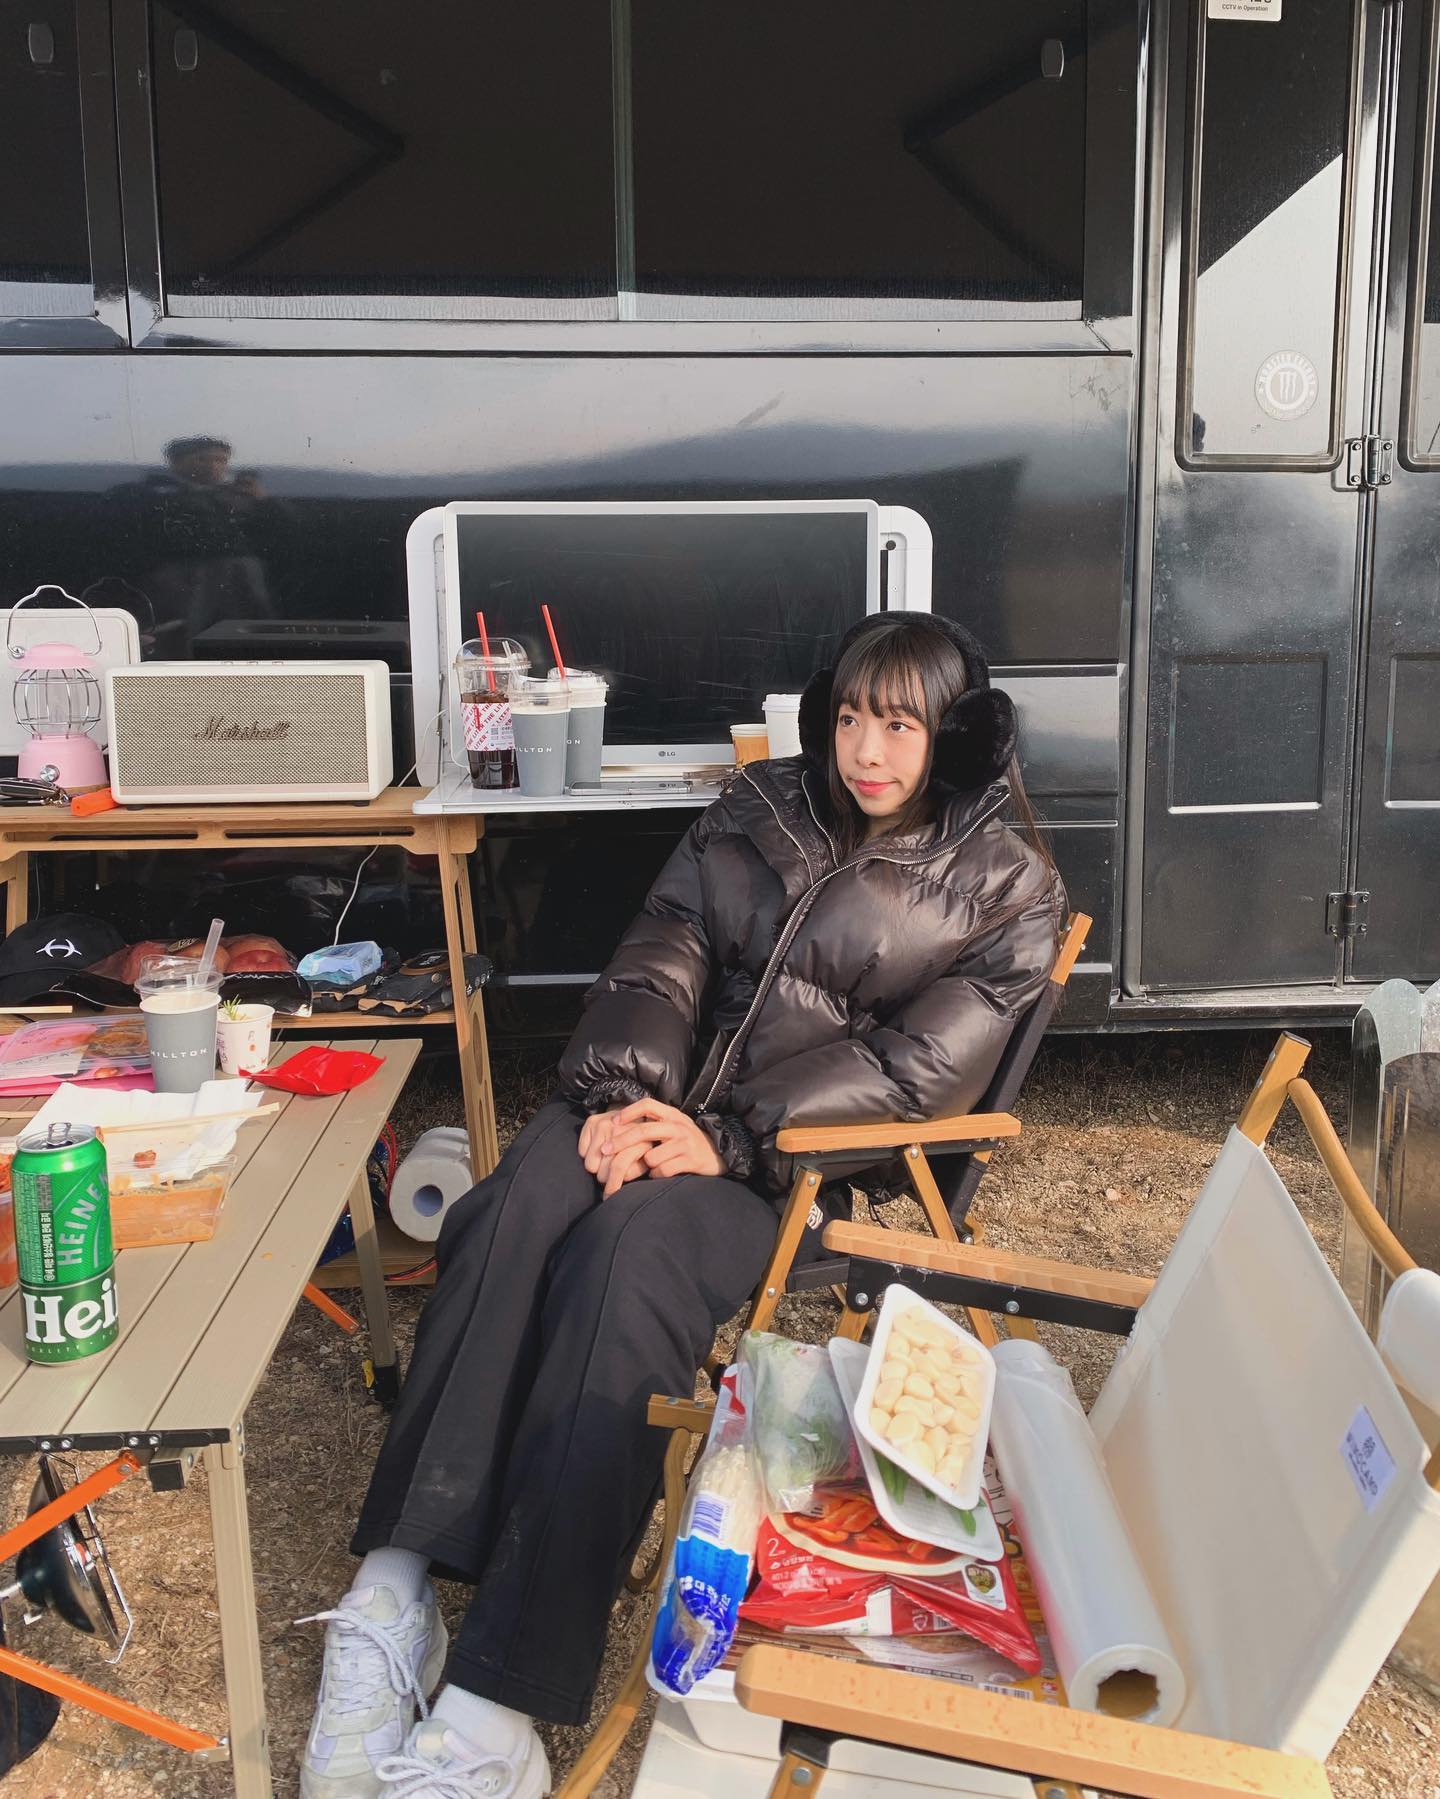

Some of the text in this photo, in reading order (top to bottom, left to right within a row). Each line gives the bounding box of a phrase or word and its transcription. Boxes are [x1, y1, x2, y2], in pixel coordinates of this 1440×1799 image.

[193, 716, 291, 740] Marshall
[150, 1048, 207, 1059] HILLTON
[22, 1278, 118, 1343] Hei
[767, 1537, 780, 1557] 2
